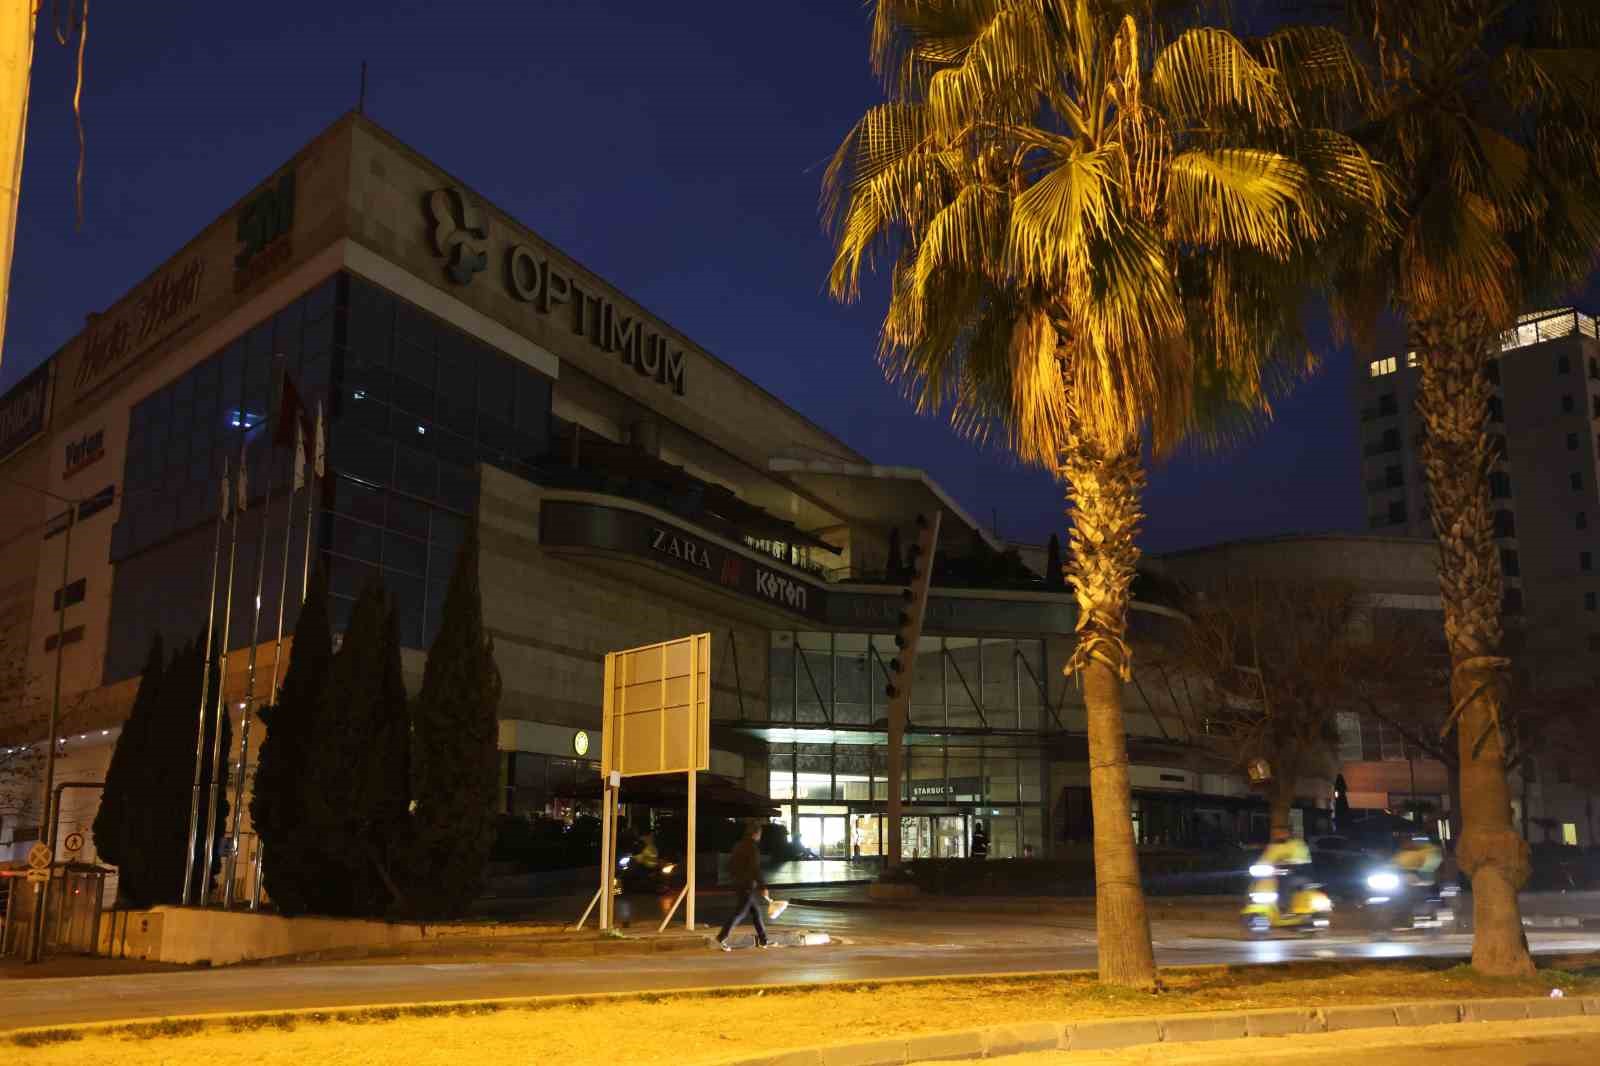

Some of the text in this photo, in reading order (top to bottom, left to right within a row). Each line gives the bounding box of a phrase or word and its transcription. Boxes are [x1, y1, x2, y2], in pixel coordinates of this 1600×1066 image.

[504, 245, 687, 395] OPTIMUM
[651, 528, 711, 569] ZARA
[913, 785, 954, 796] STARBUCS
